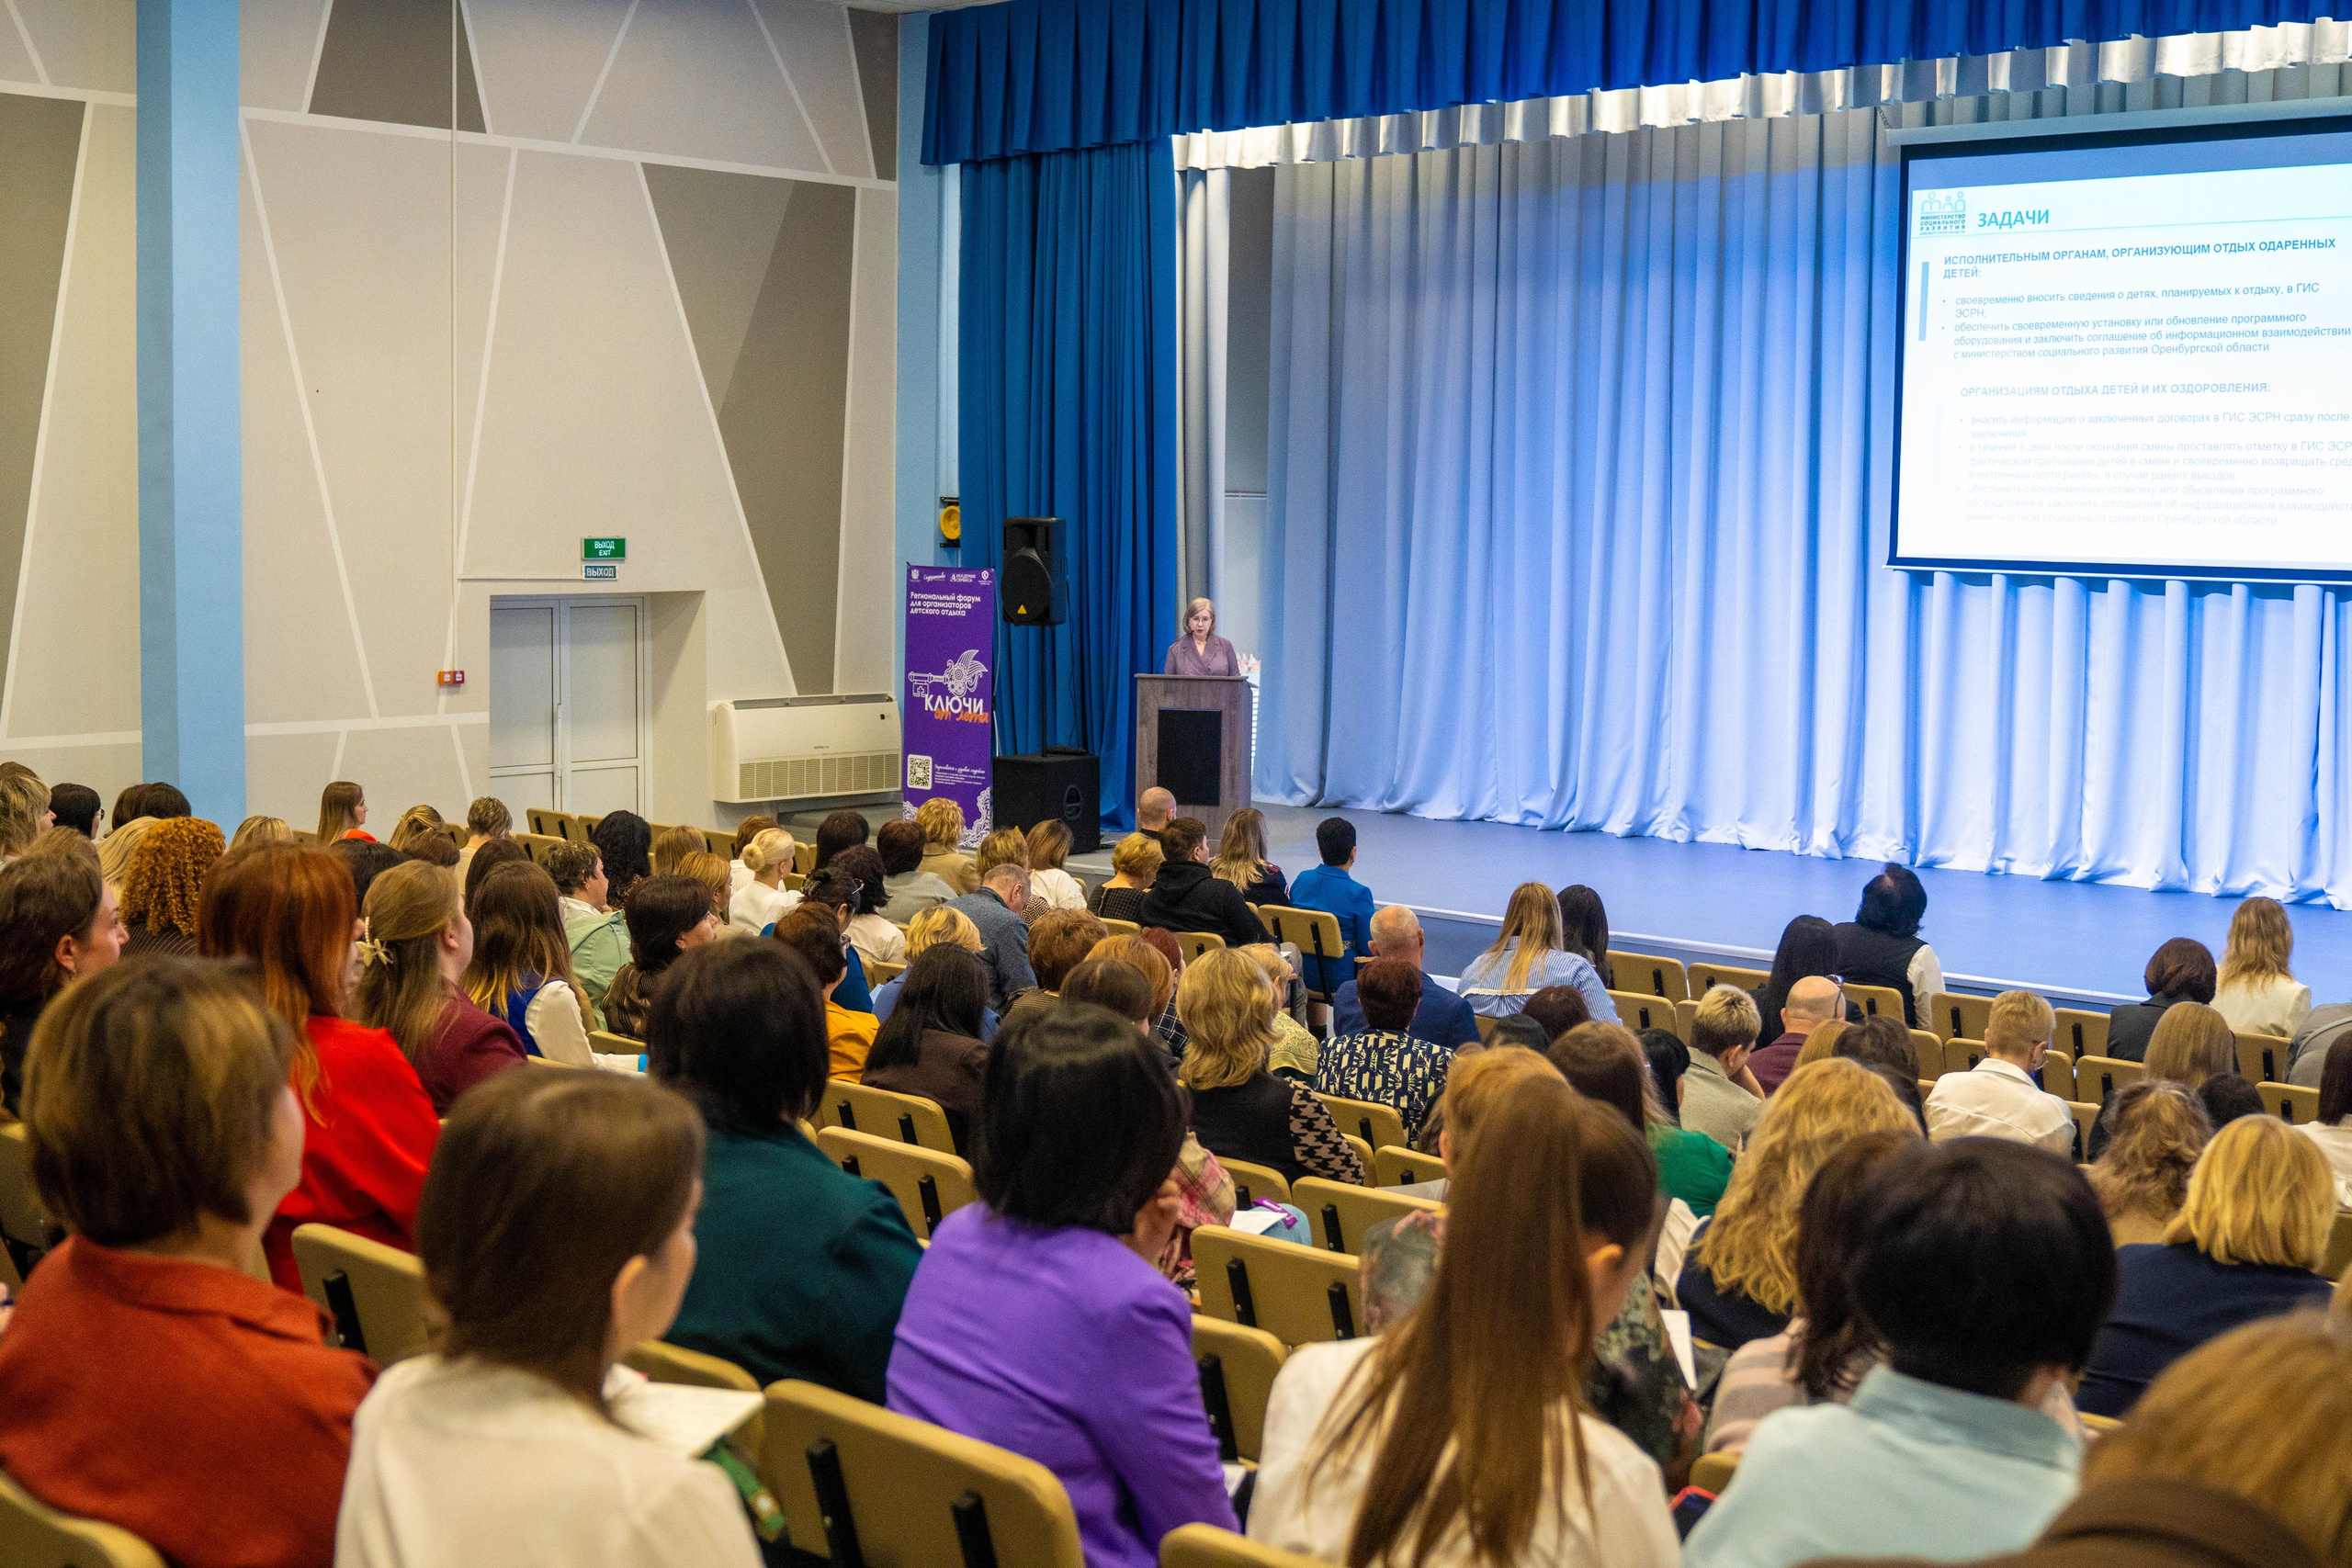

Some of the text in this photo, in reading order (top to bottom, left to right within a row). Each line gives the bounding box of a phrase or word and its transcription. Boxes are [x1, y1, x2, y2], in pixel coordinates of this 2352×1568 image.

[1977, 209, 2049, 230] ЗАДАЧИ
[1944, 239, 2335, 265] ИСПОЛНИТЕЛЬНЫМ ОРГАНАМ, ОРГАНИЗУЮЩИМ ОТДЫХ ОДАРЕННЫХ
[1943, 266, 1981, 279] ДЕТЕЙ:
[1955, 296, 2025, 306] своевременно
[2027, 293, 2065, 303] вносить
[2068, 292, 2115, 301] сведения
[2126, 290, 2159, 300] детях,
[2162, 287, 2232, 299] планируемых
[2243, 286, 2283, 296] отдыху,
[2296, 282, 2320, 293] ГИС
[1955, 309, 1987, 318] ЭСРН;
[1954, 313, 2306, 332] обеспечить своевременную установку или обновление программного
[1954, 336, 2022, 346] оборудования
[2033, 334, 2084, 344] заключить
[2086, 333, 2146, 342] соглашение
[2150, 331, 2163, 340] об
[2165, 330, 2259, 341] информационном
[2262, 327, 2351, 337] взаимодействии
[1962, 349, 2035, 359] министерством
[2038, 346, 2099, 357] социального
[2102, 345, 2148, 356] развития
[2151, 343, 2223, 355] Оренбургской
[2226, 342, 2269, 352] области
[1961, 387, 2049, 397] ОРГАНИЗАЦИЯМ
[2052, 385, 2098, 396] ОТДЫХА
[2101, 382, 2138, 395] ДЕТЕЙ
[2153, 384, 2167, 393] ИХ
[2170, 382, 2270, 394] ОЗДОРОВЛЕНИЯ:
[1971, 417, 2007, 425] вносить
[2010, 415, 2076, 425] информацию
[2087, 415, 2154, 423] заключенных
[2157, 414, 2211, 423] договорах
[2222, 412, 2245, 423] ГИС
[2248, 412, 2280, 422] ЭСРН
[2284, 413, 2313, 423] сразу
[2317, 413, 2350, 422] после
[1978, 444, 2016, 452] течение
[2027, 442, 2051, 453] дней
[2086, 443, 2138, 451] окончания
[2141, 443, 2175, 451] смены
[2177, 443, 2243, 452] проставлять
[2245, 443, 2288, 452] отметку
[2301, 441, 2324, 451] ГИС
[594, 541, 615, 549] ВЫХОД
[586, 568, 614, 577] ВЫХОД
[910, 592, 980, 603] Региональный форум
[922, 601, 971, 609] организаторов
[924, 694, 983, 715] КЛЮЧИ
[934, 708, 989, 723] от лета
